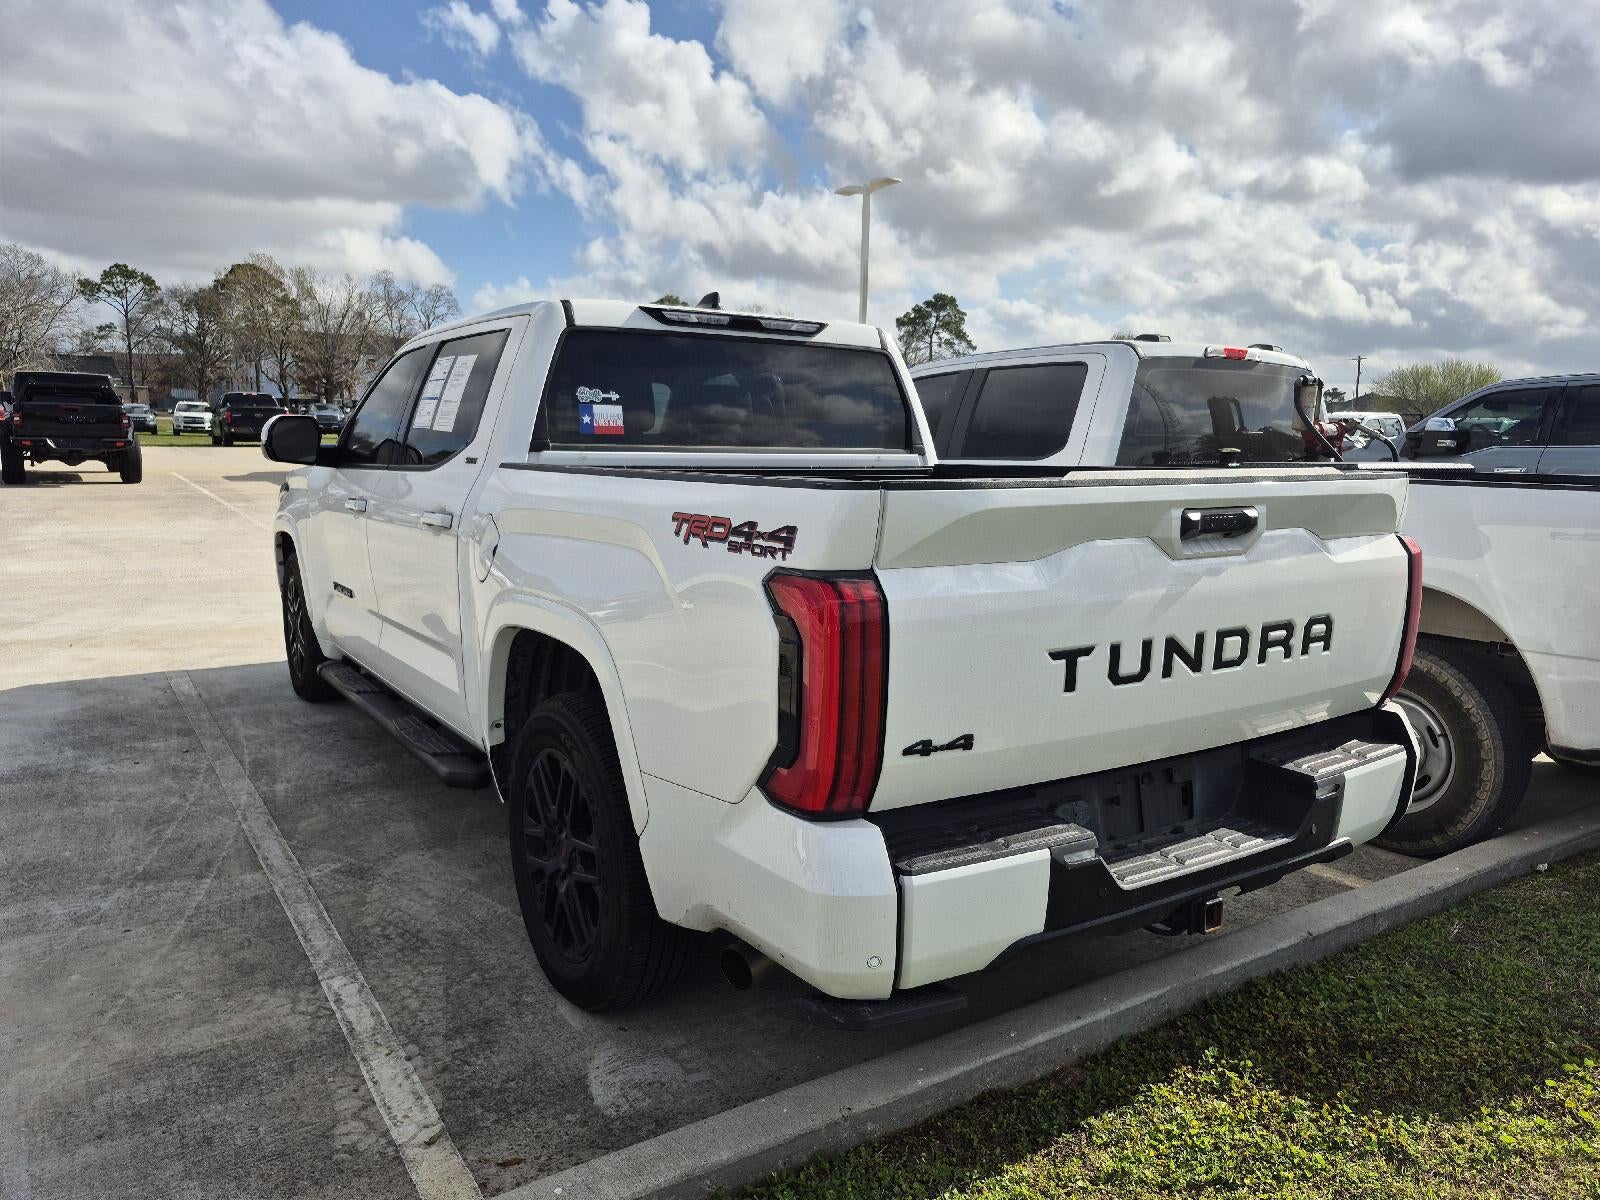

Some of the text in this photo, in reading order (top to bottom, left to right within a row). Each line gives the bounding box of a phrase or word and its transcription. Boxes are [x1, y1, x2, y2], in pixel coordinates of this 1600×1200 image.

[672, 512, 732, 548] TRD
[727, 540, 793, 561] SPORT
[1048, 614, 1333, 694] TUNDRA
